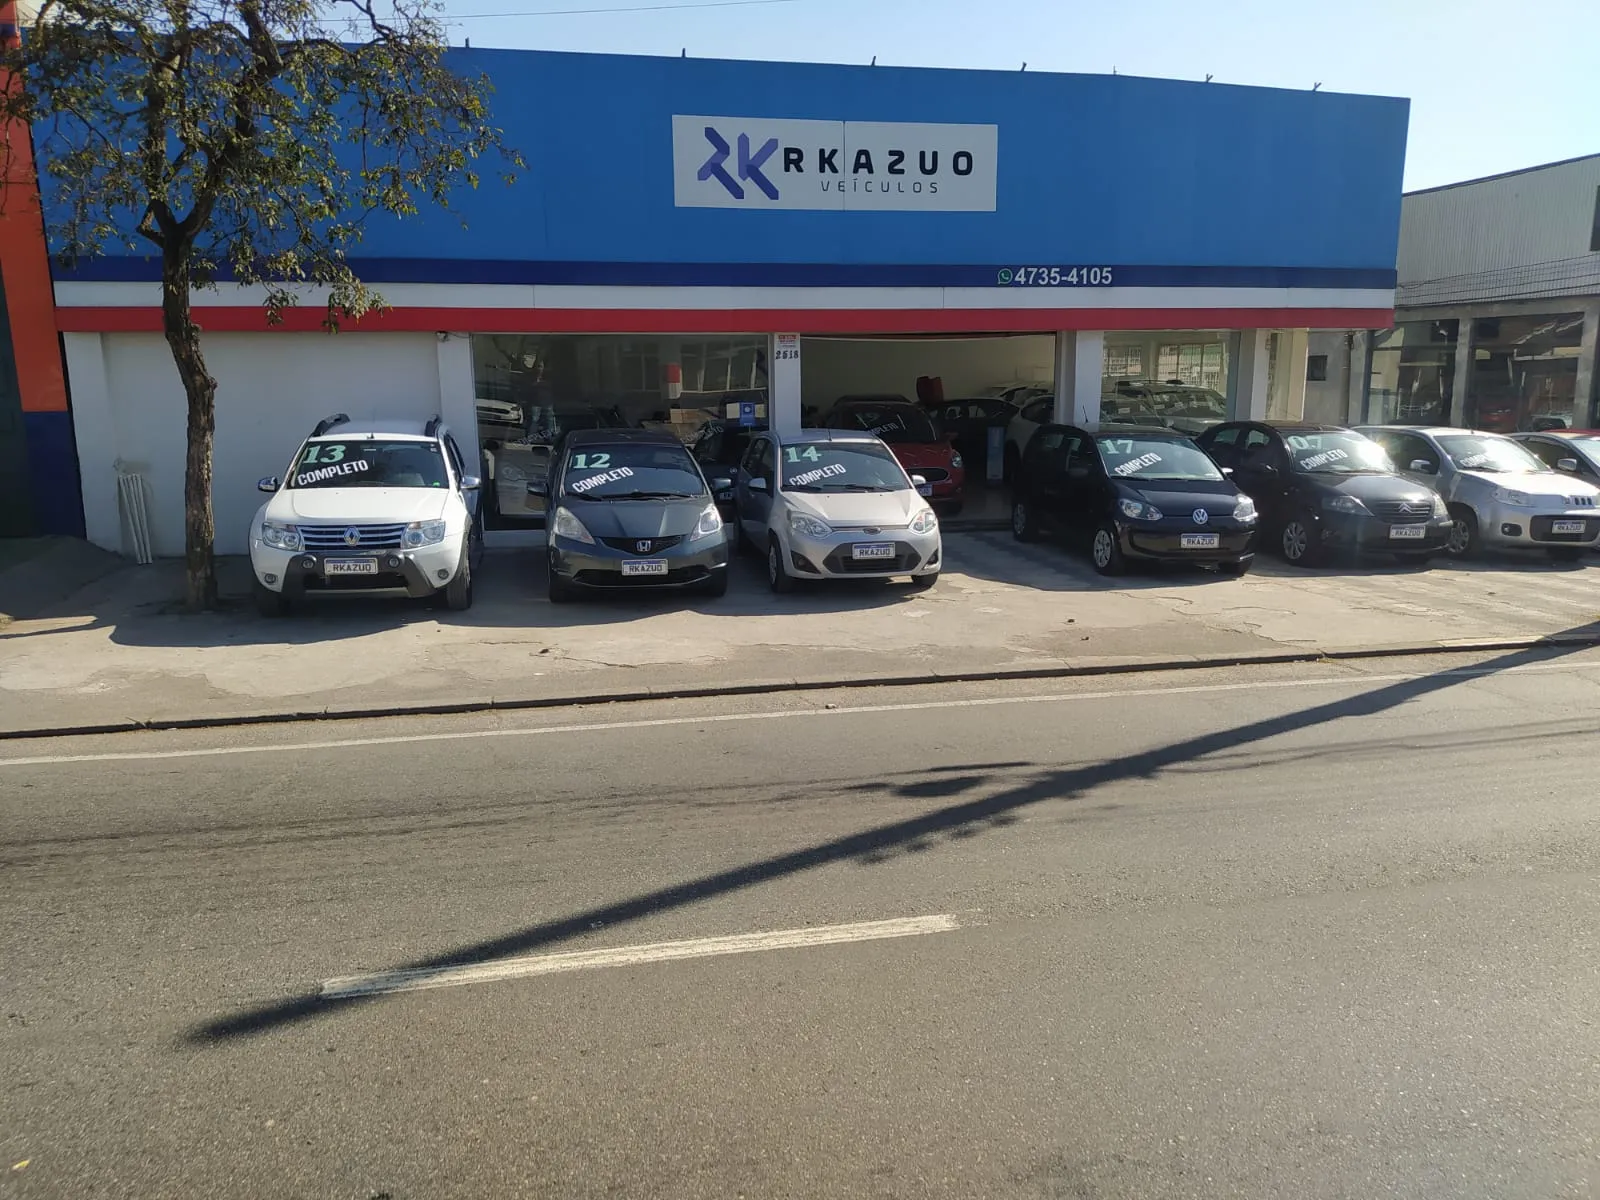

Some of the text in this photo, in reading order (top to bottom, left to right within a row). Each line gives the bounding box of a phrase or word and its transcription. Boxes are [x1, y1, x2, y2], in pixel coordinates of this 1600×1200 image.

[820, 177, 939, 194] VEÍCULOS
[1014, 266, 1113, 285] 4735-4105
[303, 444, 347, 464] 13
[785, 446, 822, 463] 14
[1101, 439, 1133, 455] 17
[573, 453, 611, 469] 12
[1114, 452, 1163, 477] COMPLETO
[1300, 448, 1349, 471] COMPLETO
[297, 459, 369, 487] COMPLETO
[571, 466, 634, 493] COMPLETO
[789, 463, 847, 487] COMPLETO
[332, 562, 372, 572] RKAZUO
